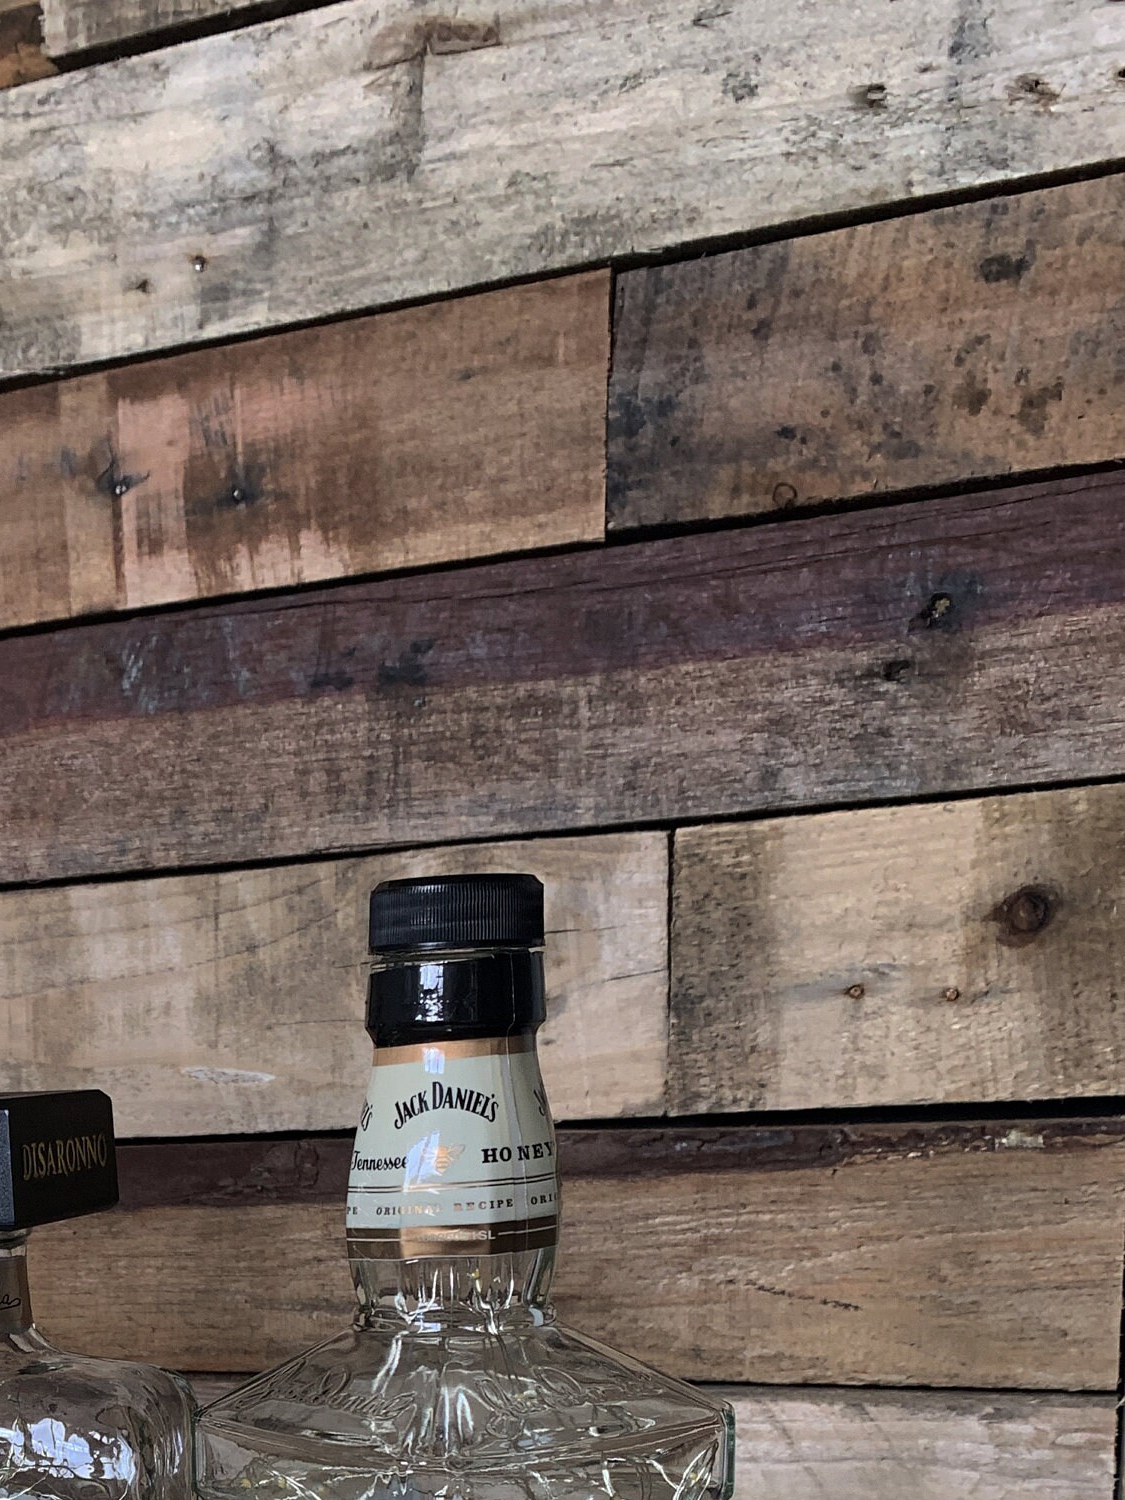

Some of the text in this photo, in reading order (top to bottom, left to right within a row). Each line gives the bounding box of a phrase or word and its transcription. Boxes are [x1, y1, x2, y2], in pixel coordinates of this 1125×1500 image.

[394, 1090, 430, 1130] JACK
[432, 1081, 499, 1123] DANIEL'S
[22, 1133, 108, 1181] DISARONNO
[351, 1151, 408, 1171] Tennessee
